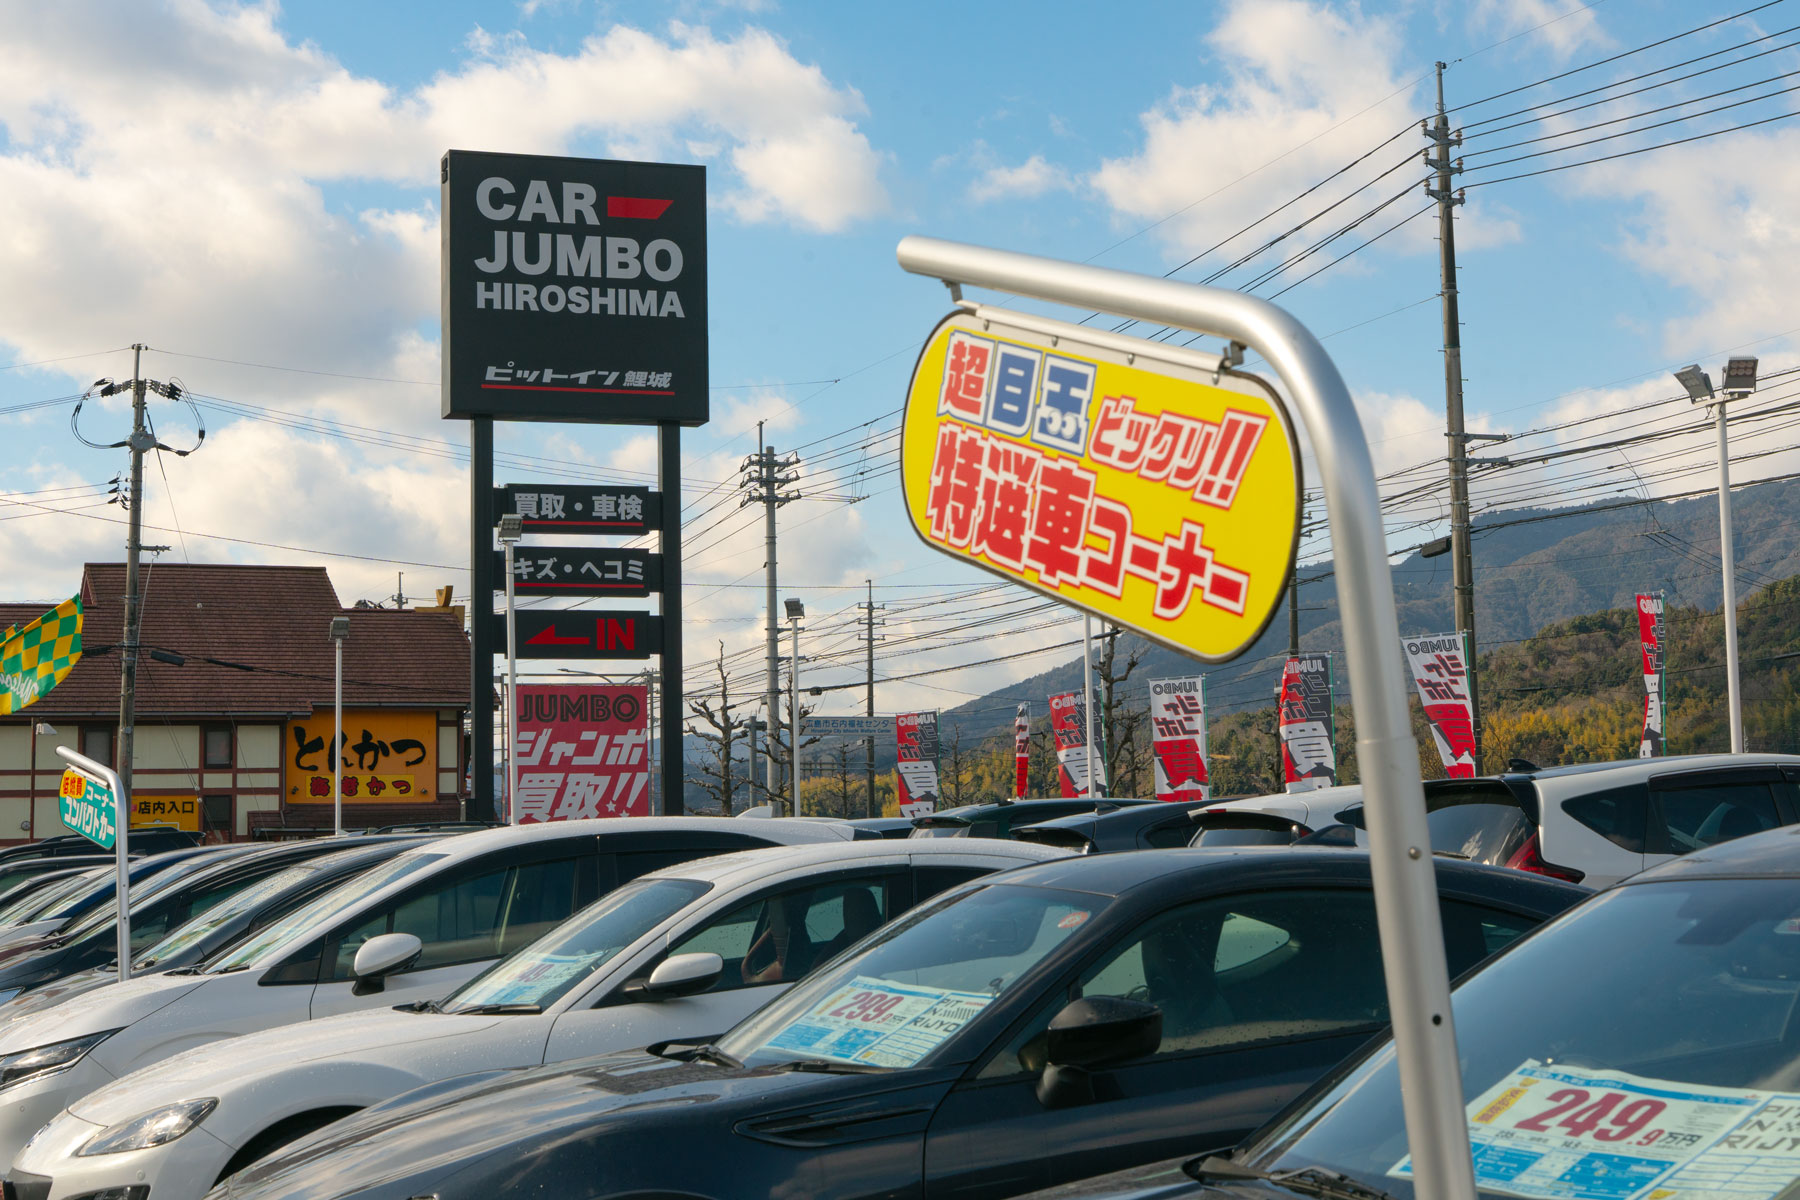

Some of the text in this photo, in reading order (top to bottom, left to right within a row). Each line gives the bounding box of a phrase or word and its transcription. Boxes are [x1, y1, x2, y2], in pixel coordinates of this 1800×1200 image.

[476, 177, 600, 225] CAR
[474, 231, 684, 282] JUMBO
[476, 281, 686, 318] HIROSHIMA
[514, 493, 644, 520] 買取・車検
[926, 421, 1250, 621] 特選車コーナー
[514, 557, 644, 581] キズ・ヘコミ
[596, 618, 635, 651] IN
[519, 694, 640, 723] JUMBO
[293, 726, 426, 773] とんかつ
[517, 728, 648, 766] ジャンボ
[64, 795, 115, 841] コンパクトカー
[138, 801, 194, 814] 店内入口
